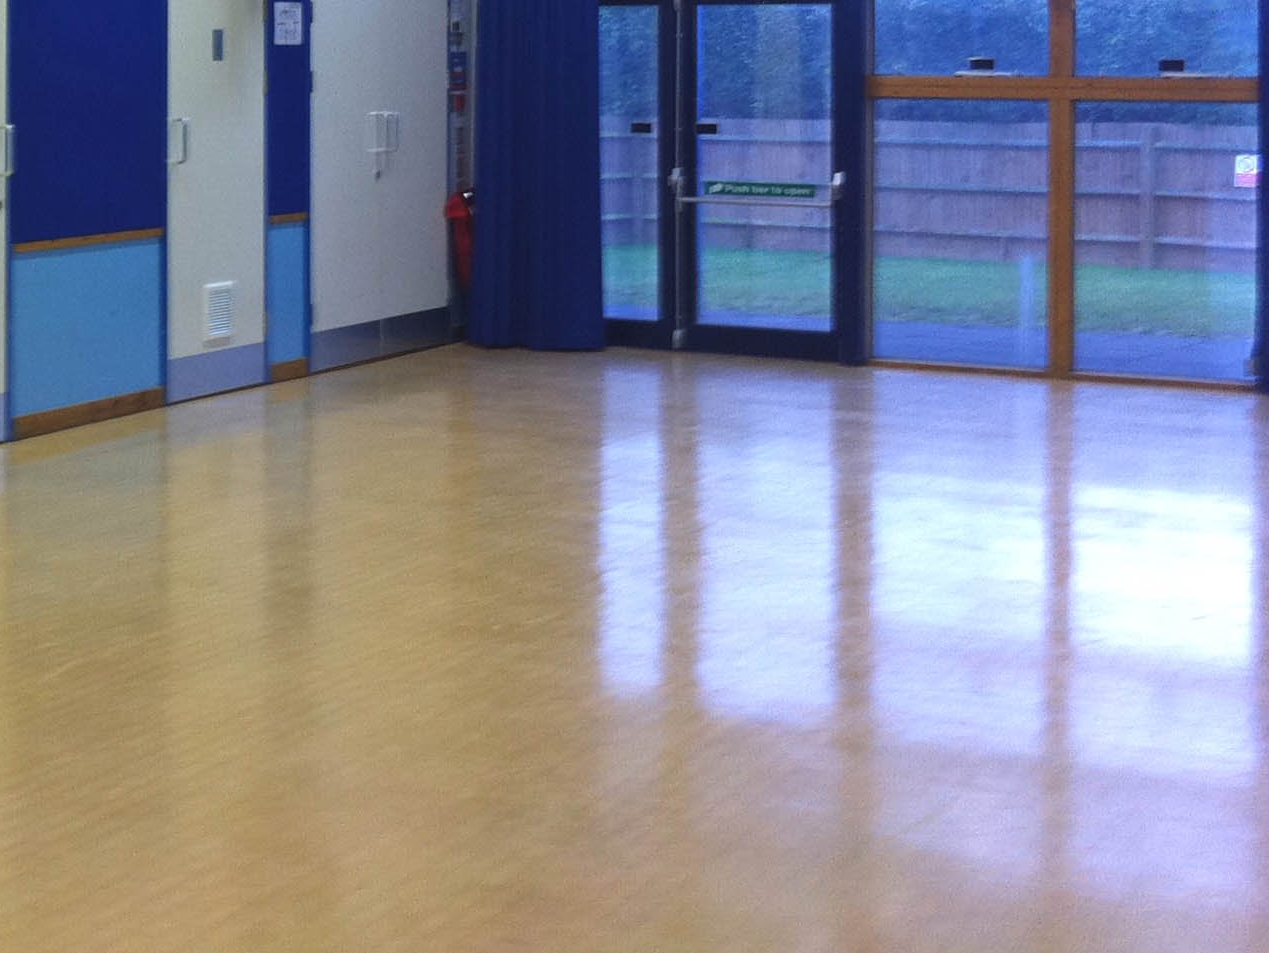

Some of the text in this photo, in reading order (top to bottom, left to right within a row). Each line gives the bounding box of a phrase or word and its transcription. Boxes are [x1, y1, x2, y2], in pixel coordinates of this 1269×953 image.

[724, 184, 811, 197] Push bar to open
